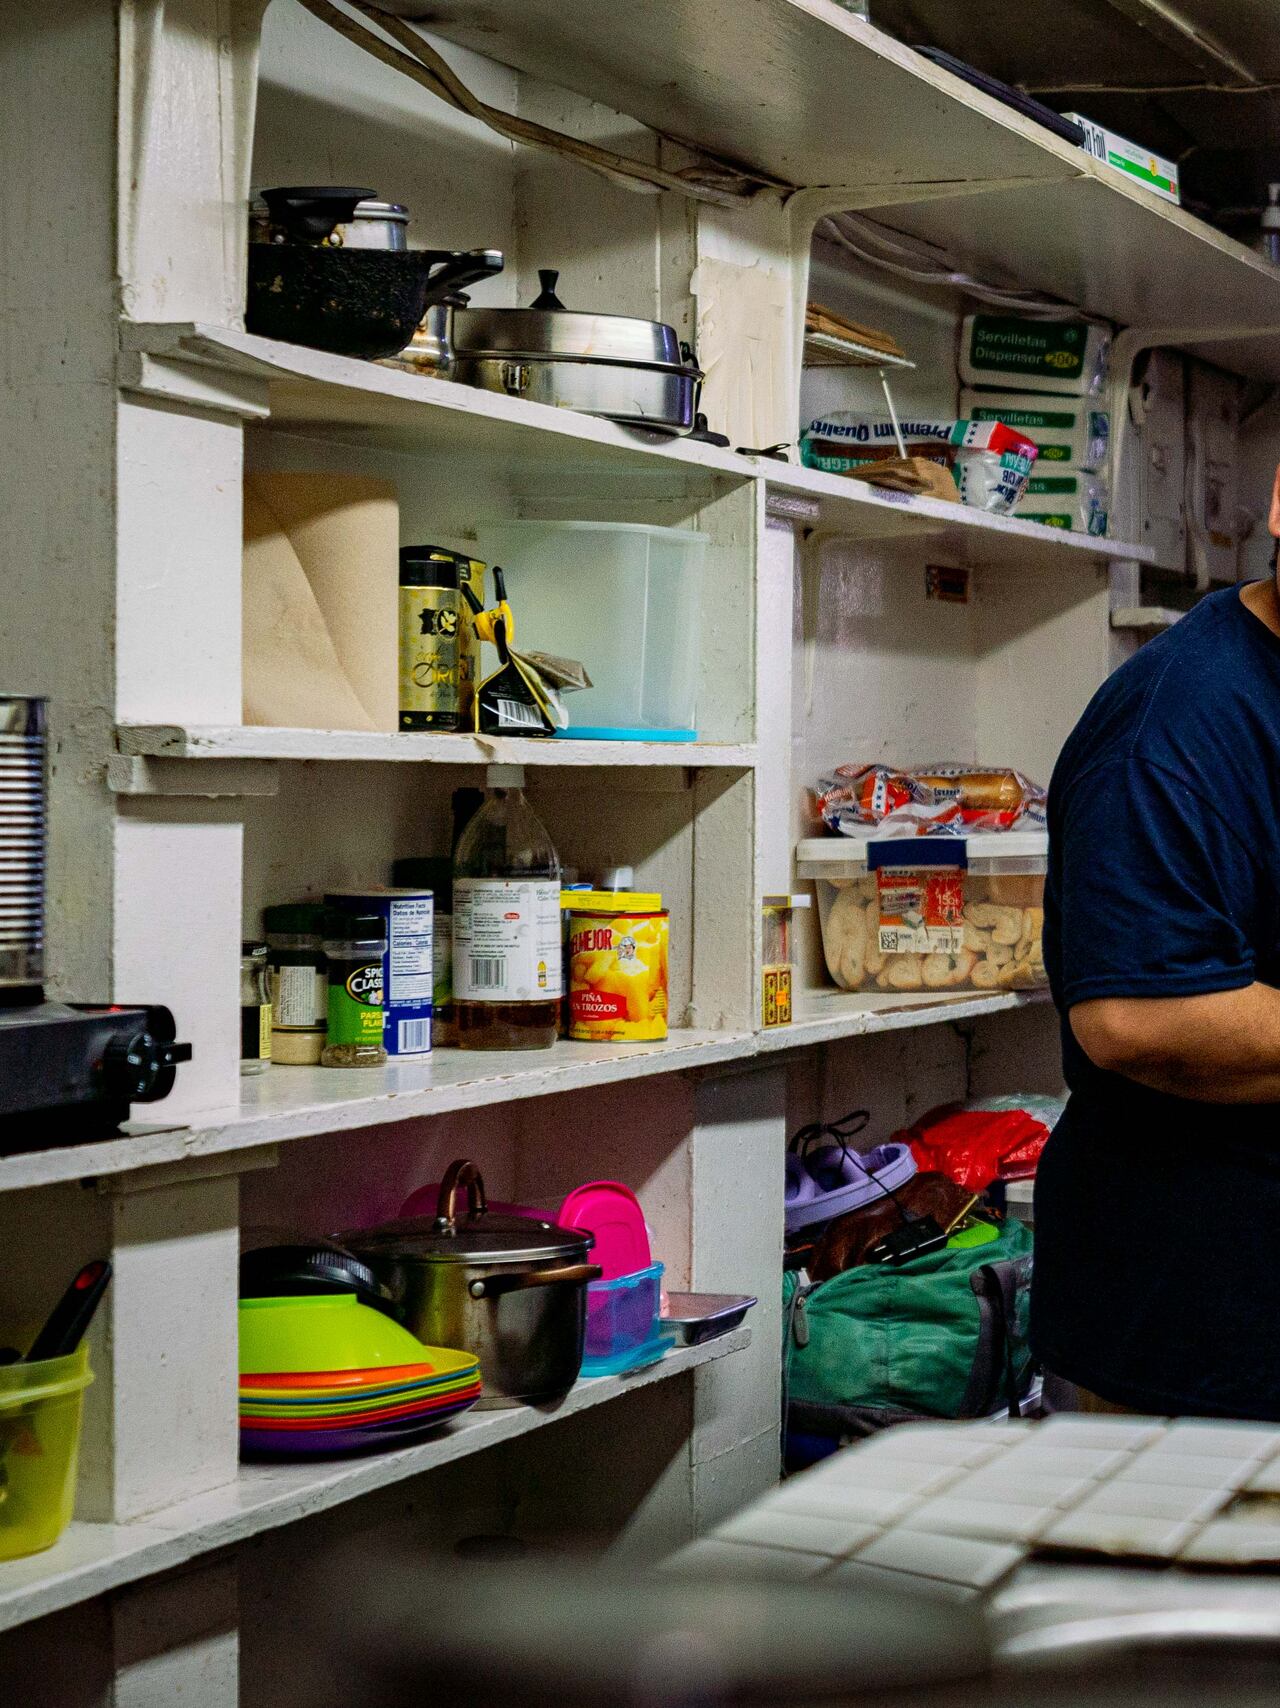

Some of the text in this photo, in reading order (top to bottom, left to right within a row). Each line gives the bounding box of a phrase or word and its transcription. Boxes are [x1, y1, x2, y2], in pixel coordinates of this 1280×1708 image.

[977, 329, 1048, 348] Servilletas
[975, 346, 1043, 365] Dispenser
[810, 419, 869, 442] Quality
[580, 928, 613, 952] MEJOR
[581, 992, 602, 1002] PIÑA
[582, 1003, 618, 1013] TROZOS
